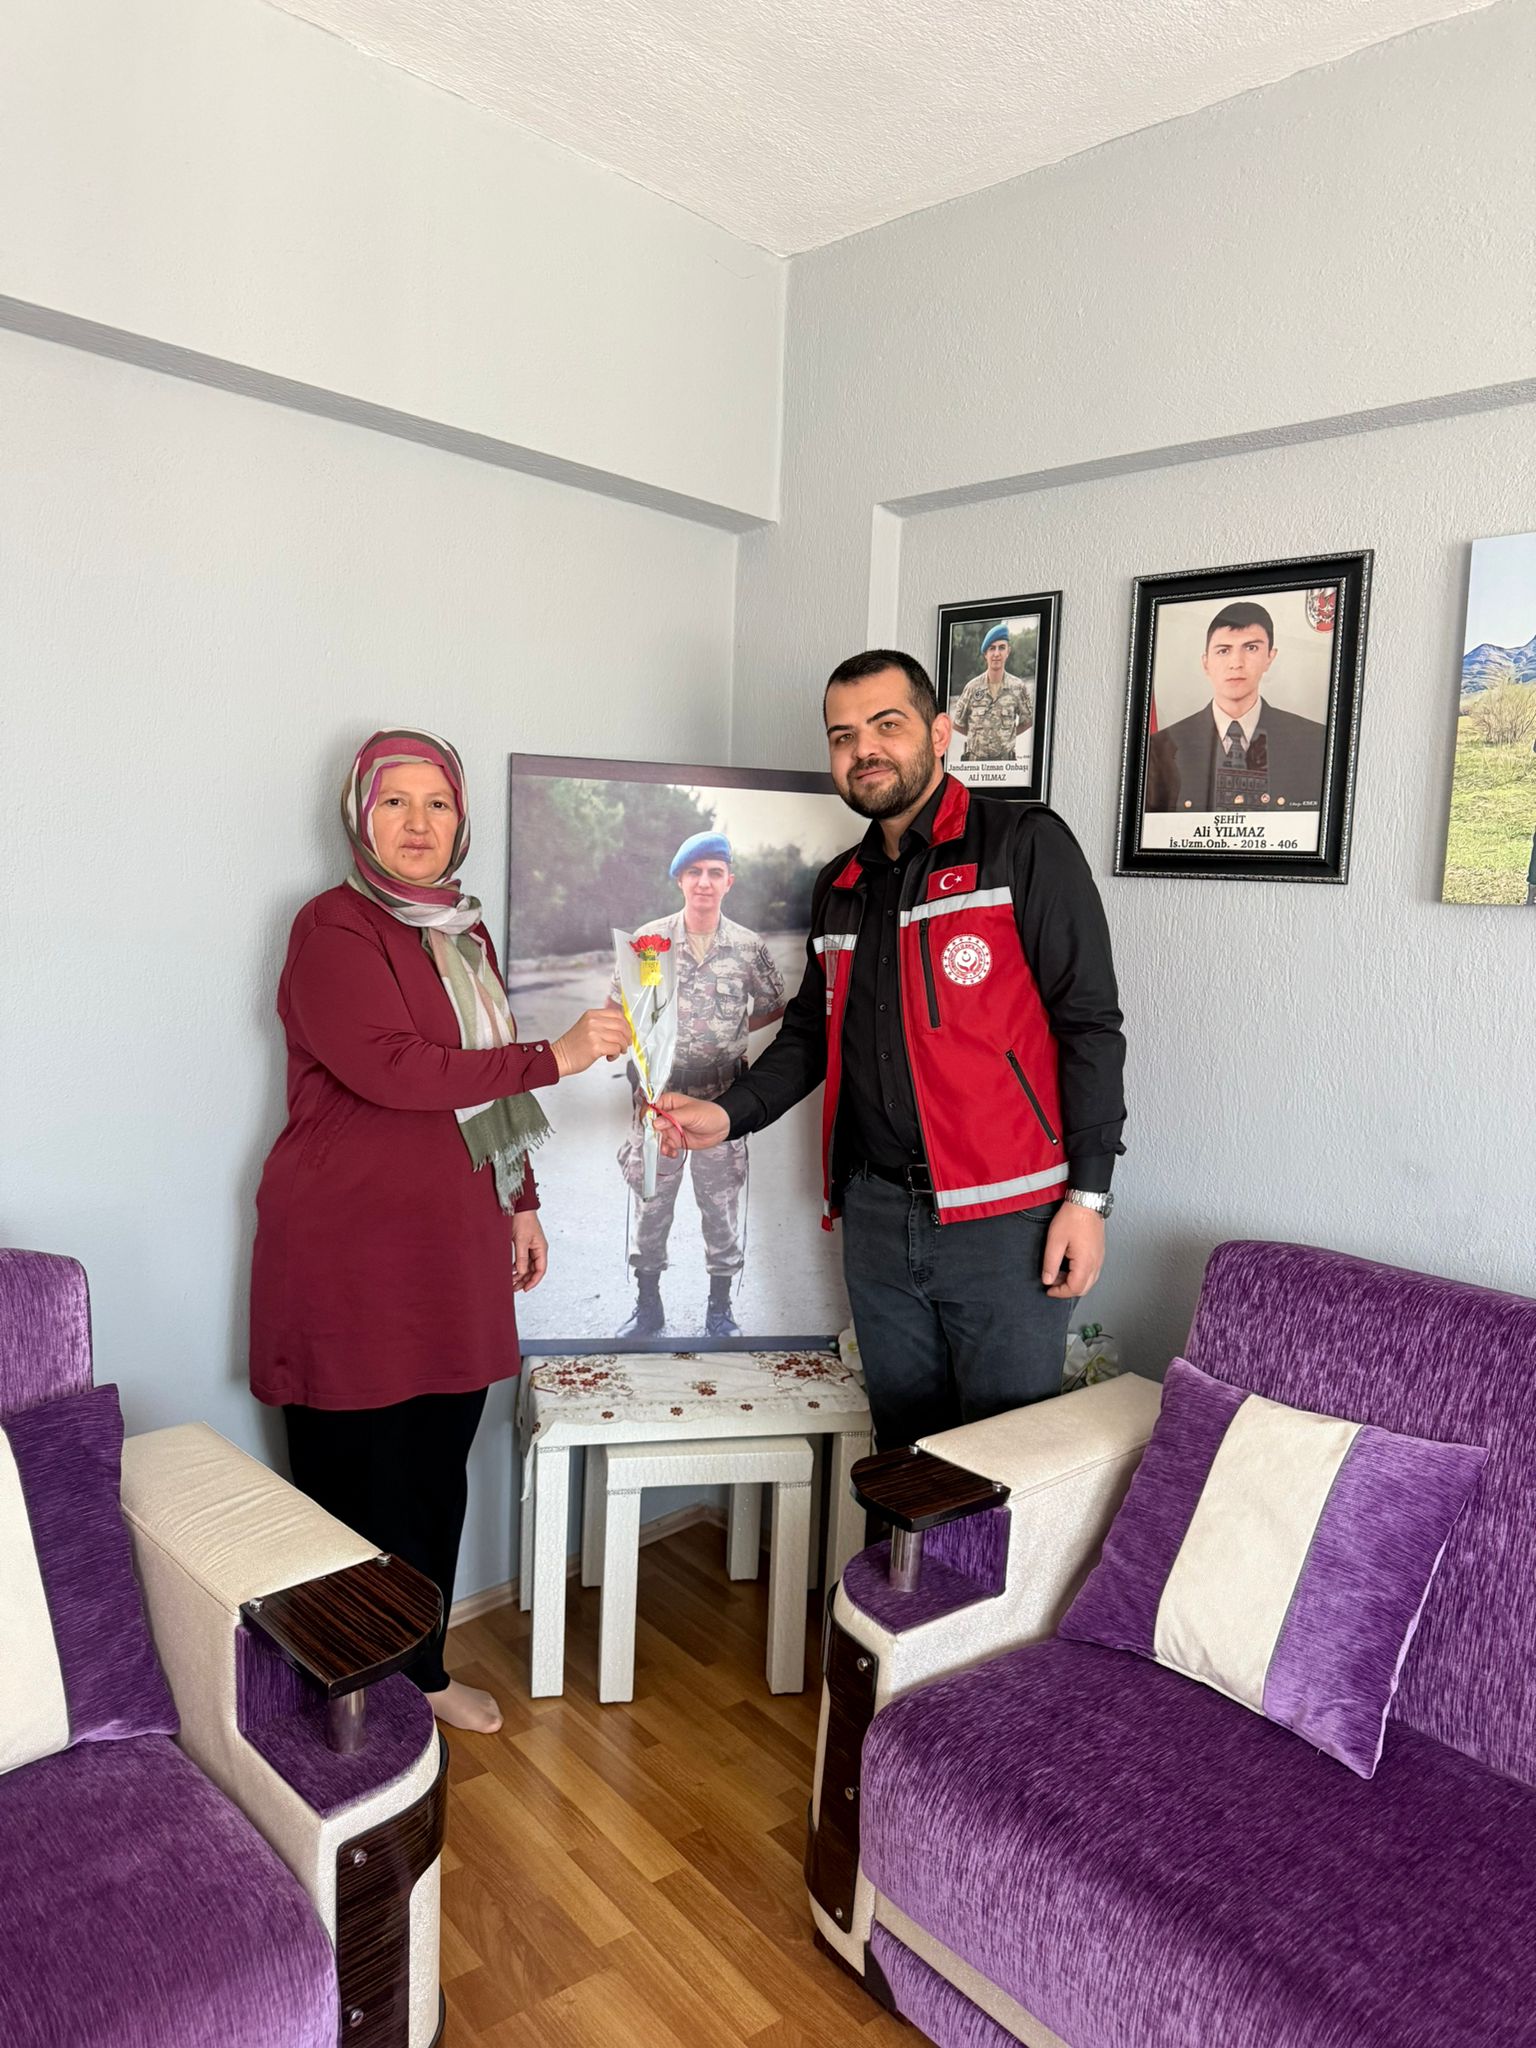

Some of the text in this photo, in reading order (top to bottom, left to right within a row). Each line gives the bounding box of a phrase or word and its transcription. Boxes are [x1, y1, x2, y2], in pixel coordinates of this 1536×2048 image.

[981, 763, 1004, 771] Uzman
[968, 773, 1007, 781] ALİ YILMAZ
[1213, 812, 1246, 826] ŞEHİT
[1193, 826, 1265, 837] Ali YILMAZ
[1169, 837, 1230, 849] İs.Uzm.Onb.
[1240, 839, 1267, 848] 2018
[1277, 839, 1298, 848] 406
